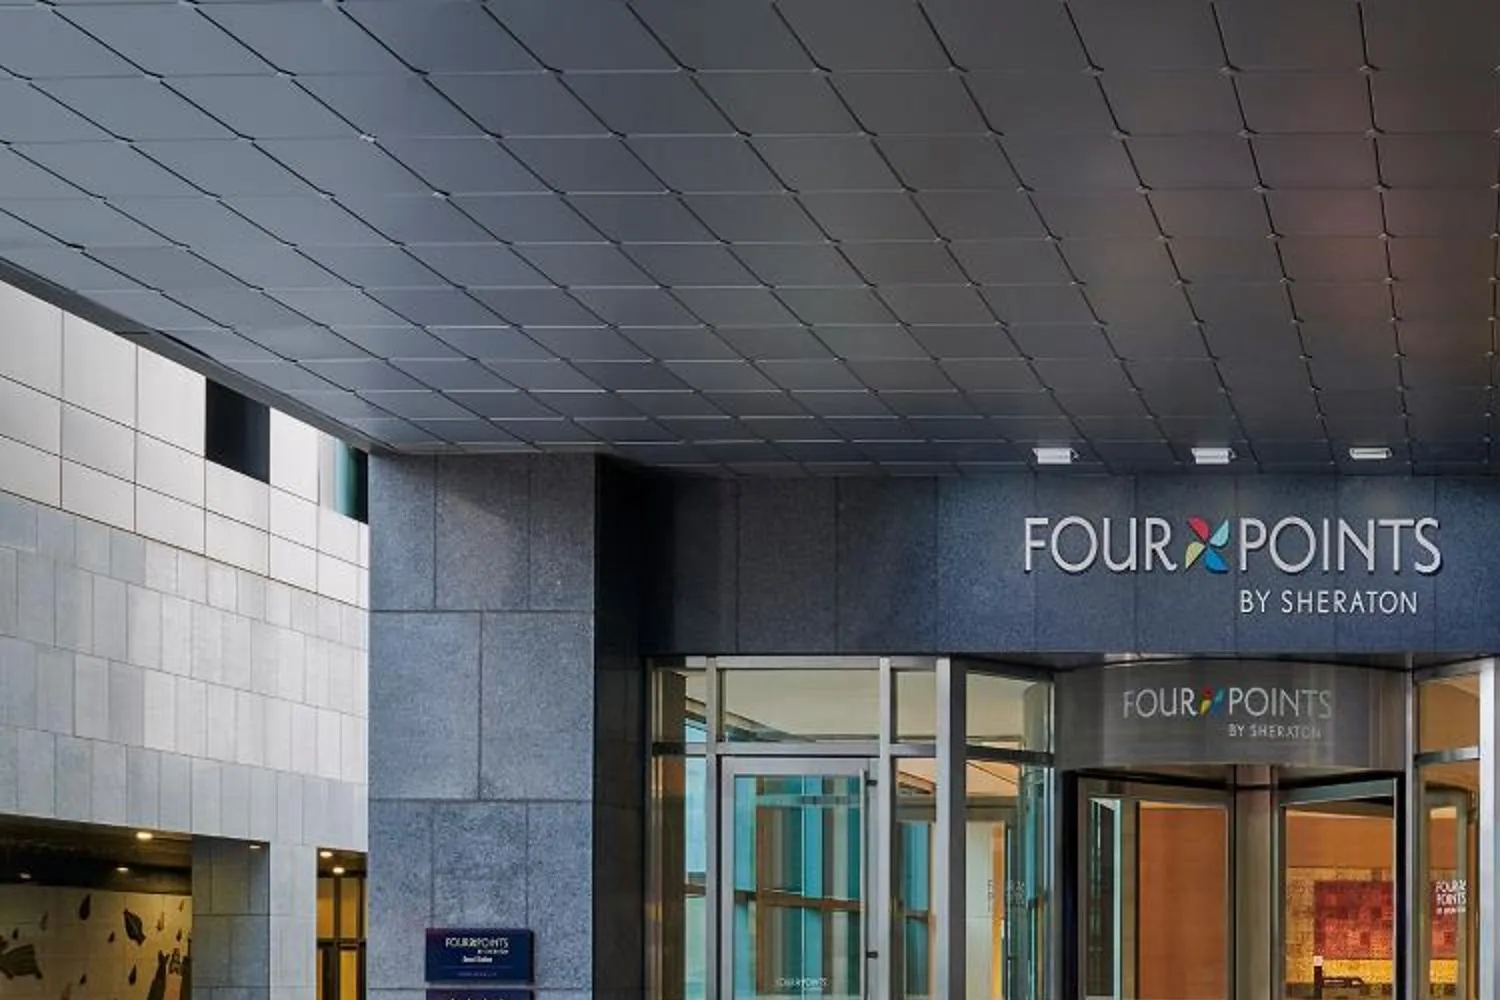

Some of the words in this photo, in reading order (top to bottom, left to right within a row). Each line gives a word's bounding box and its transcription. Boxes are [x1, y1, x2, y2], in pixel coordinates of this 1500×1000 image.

[1024, 515, 1178, 574] FOUR
[1239, 516, 1443, 575] POINTS
[1240, 589, 1271, 614] BY
[1281, 588, 1418, 614] SHERATON
[1123, 687, 1197, 719] FOUR
[1228, 687, 1333, 720] POINTS
[1228, 723, 1245, 737] BY
[1436, 893, 1467, 906] POINTS
